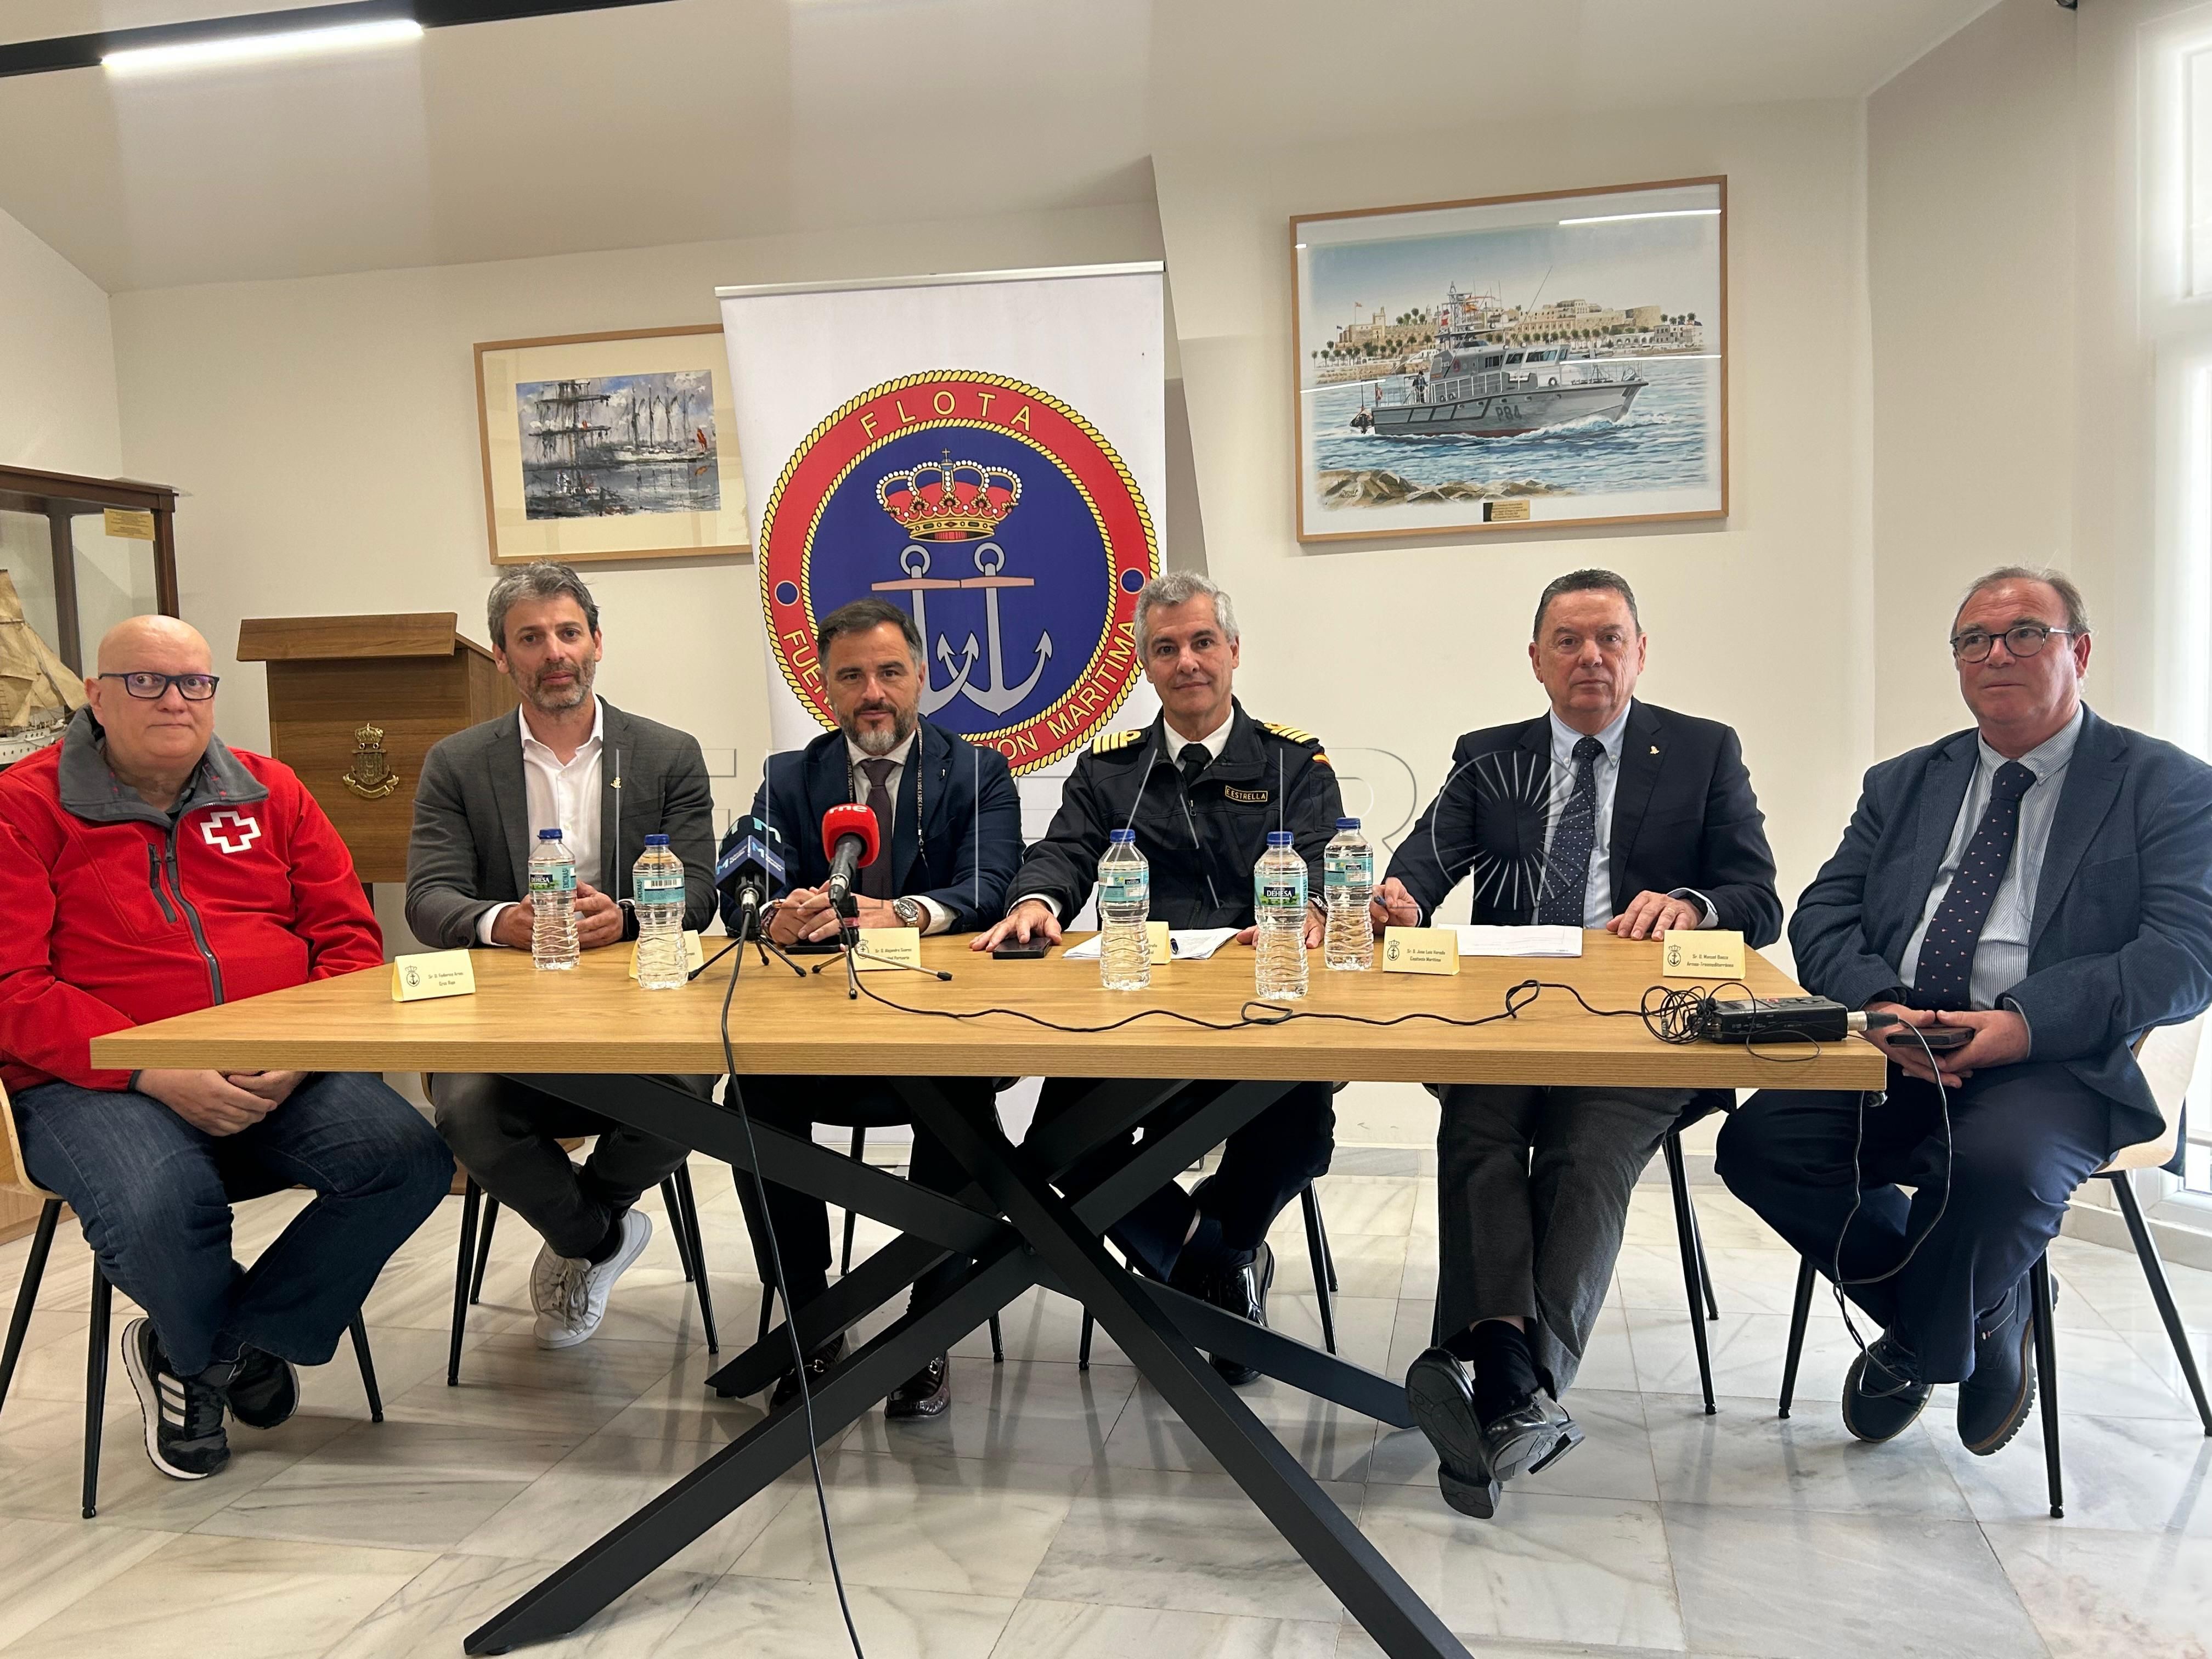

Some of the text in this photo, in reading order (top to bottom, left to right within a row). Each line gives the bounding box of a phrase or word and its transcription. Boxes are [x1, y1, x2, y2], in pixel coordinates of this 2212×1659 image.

[860, 390, 1032, 439] FLOTA
[1496, 404, 1522, 422] P84
[829, 805, 868, 814] rne
